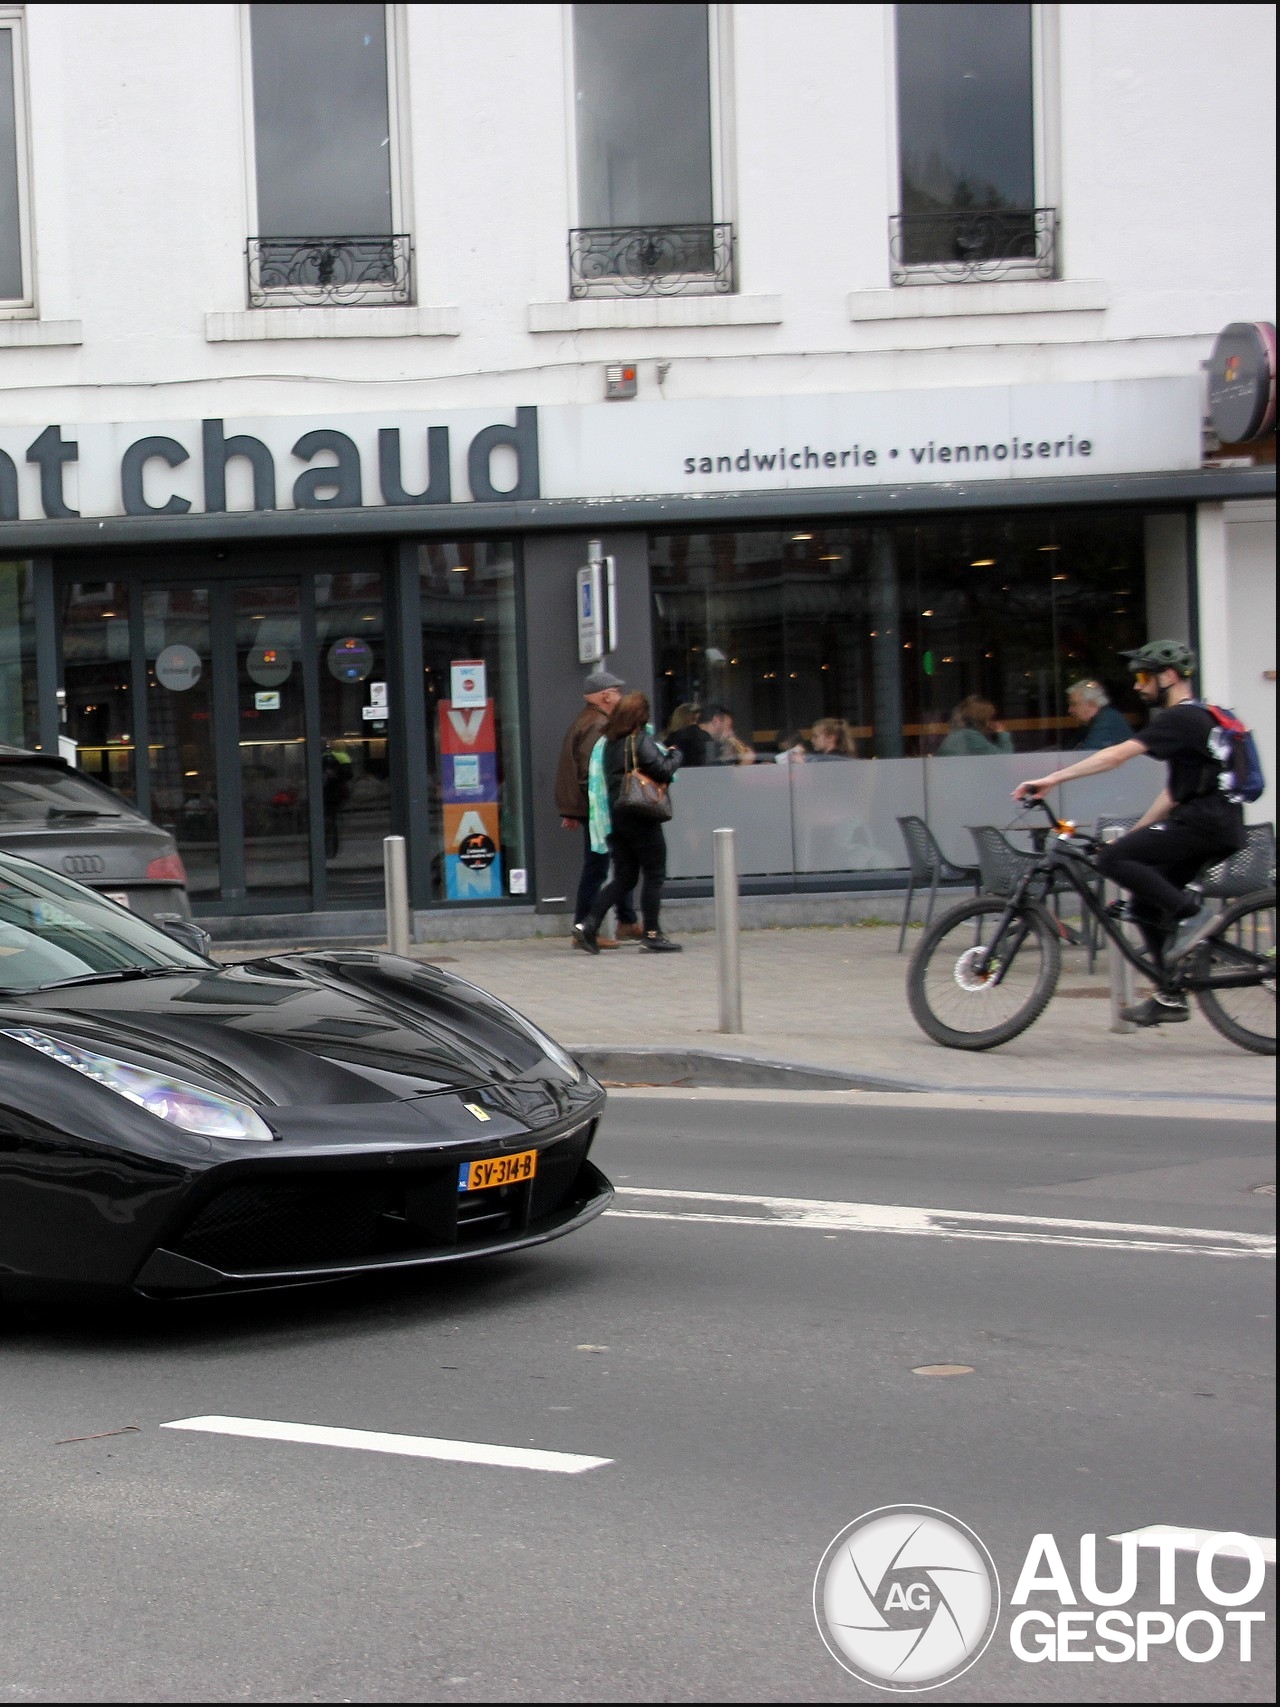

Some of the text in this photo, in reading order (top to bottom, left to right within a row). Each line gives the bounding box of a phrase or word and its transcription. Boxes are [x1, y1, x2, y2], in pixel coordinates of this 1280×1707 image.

[121, 406, 541, 516] chaud
[683, 434, 1093, 475] sandwicherie viennoiserie
[473, 1155, 532, 1187] SV-314-B
